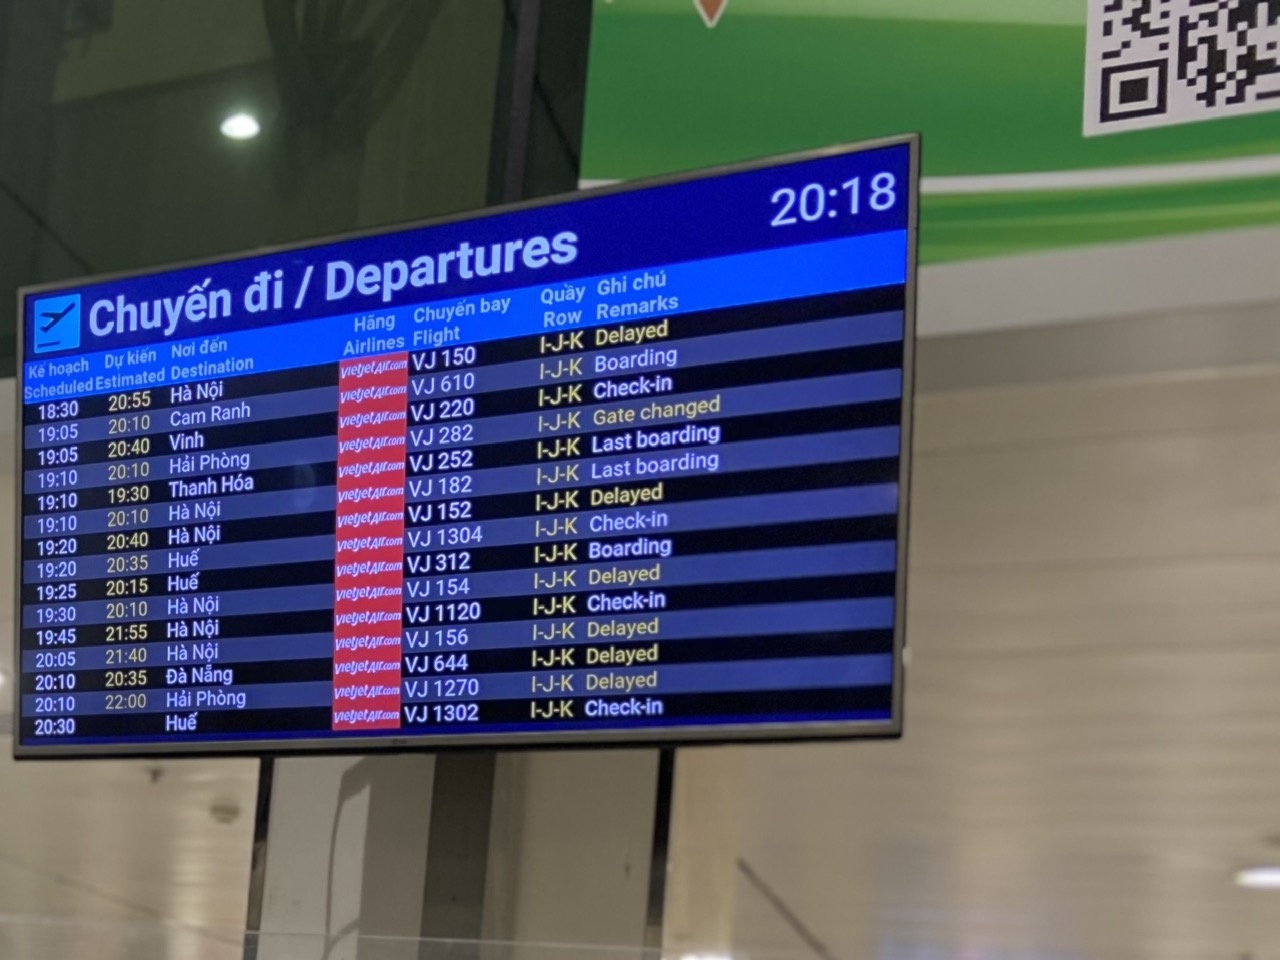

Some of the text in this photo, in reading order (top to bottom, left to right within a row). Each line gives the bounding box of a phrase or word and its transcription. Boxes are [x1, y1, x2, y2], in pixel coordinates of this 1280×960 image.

[771, 171, 897, 227] 20:18
[89, 229, 579, 336] Chuyến đi / Departures
[540, 283, 585, 306] Quầy
[596, 270, 667, 296] Ghi chú
[354, 314, 395, 334] Hãng
[414, 297, 510, 327] Chuyến bay
[24, 296, 678, 399] Scheduled Estimated Destination Airlines Flight Row Remarks
[29, 358, 89, 379] Kế hoạch
[38, 401, 79, 420] 18:30
[108, 391, 151, 412] 20:55
[171, 385, 192, 404] Hà
[197, 381, 223, 402] Nội
[412, 352, 435, 371] VJ
[442, 347, 476, 367] 150
[540, 332, 583, 353] I-J-K
[595, 319, 668, 347] Delayed
[105, 348, 157, 370] Dự kiến
[172, 337, 227, 358] Nơi đến
[38, 347, 677, 443] 19:05 20:10 Cam Ranh VJ 610 I-J-K Boarding
[38, 374, 673, 466] 19:05 20:40 Vinh VJ 220 I-J-K Check-in
[38, 395, 720, 488] 19:10 20:10 Hải Phòng VJ 282 I-J-K Gate changed
[38, 424, 720, 512] 19:10 19:30 Thanh Hóa VJ 252 I-J-K Last boarding
[38, 453, 719, 533] 19:10 20:10 Hà Nội VJ 182 I-J-K Last boarding
[38, 483, 663, 556] 19:20 20:40 Hà Nội VJ 152 I-J-K Delayed
[37, 561, 76, 579] 19:20
[107, 555, 148, 573] 20:35
[169, 547, 200, 567] Huế
[408, 531, 432, 549] VJ
[438, 526, 482, 545] 1304
[535, 518, 578, 537] I-J-K
[590, 511, 668, 533] Check-in
[37, 537, 672, 600] 19:25 20:15 Huế VJ 312 I-J-K Boarding
[36, 593, 666, 646] 19:45 21:55 Hà Nội VJ 1120 I-J-K Check-in
[37, 564, 660, 623] 19:30 20:10 Hà Nội VJ 154 I-J-K Delayed
[35, 644, 659, 691] 20:10 20:35 Đà Nẵng VJ 644 I-J-K Delayed
[36, 617, 659, 668] 20:05 21:40 Hà Nội VJ 156 I-J-K Delayed
[35, 671, 657, 712] 20:10 22:00 Hải Phòng VJ 1270 I-J-K Delayed
[35, 718, 75, 735] 20:30
[166, 712, 198, 731] Huế
[404, 707, 428, 722] VJ
[433, 704, 479, 722] 1302
[531, 701, 574, 719] I-J-K
[584, 698, 664, 717] Check-in
